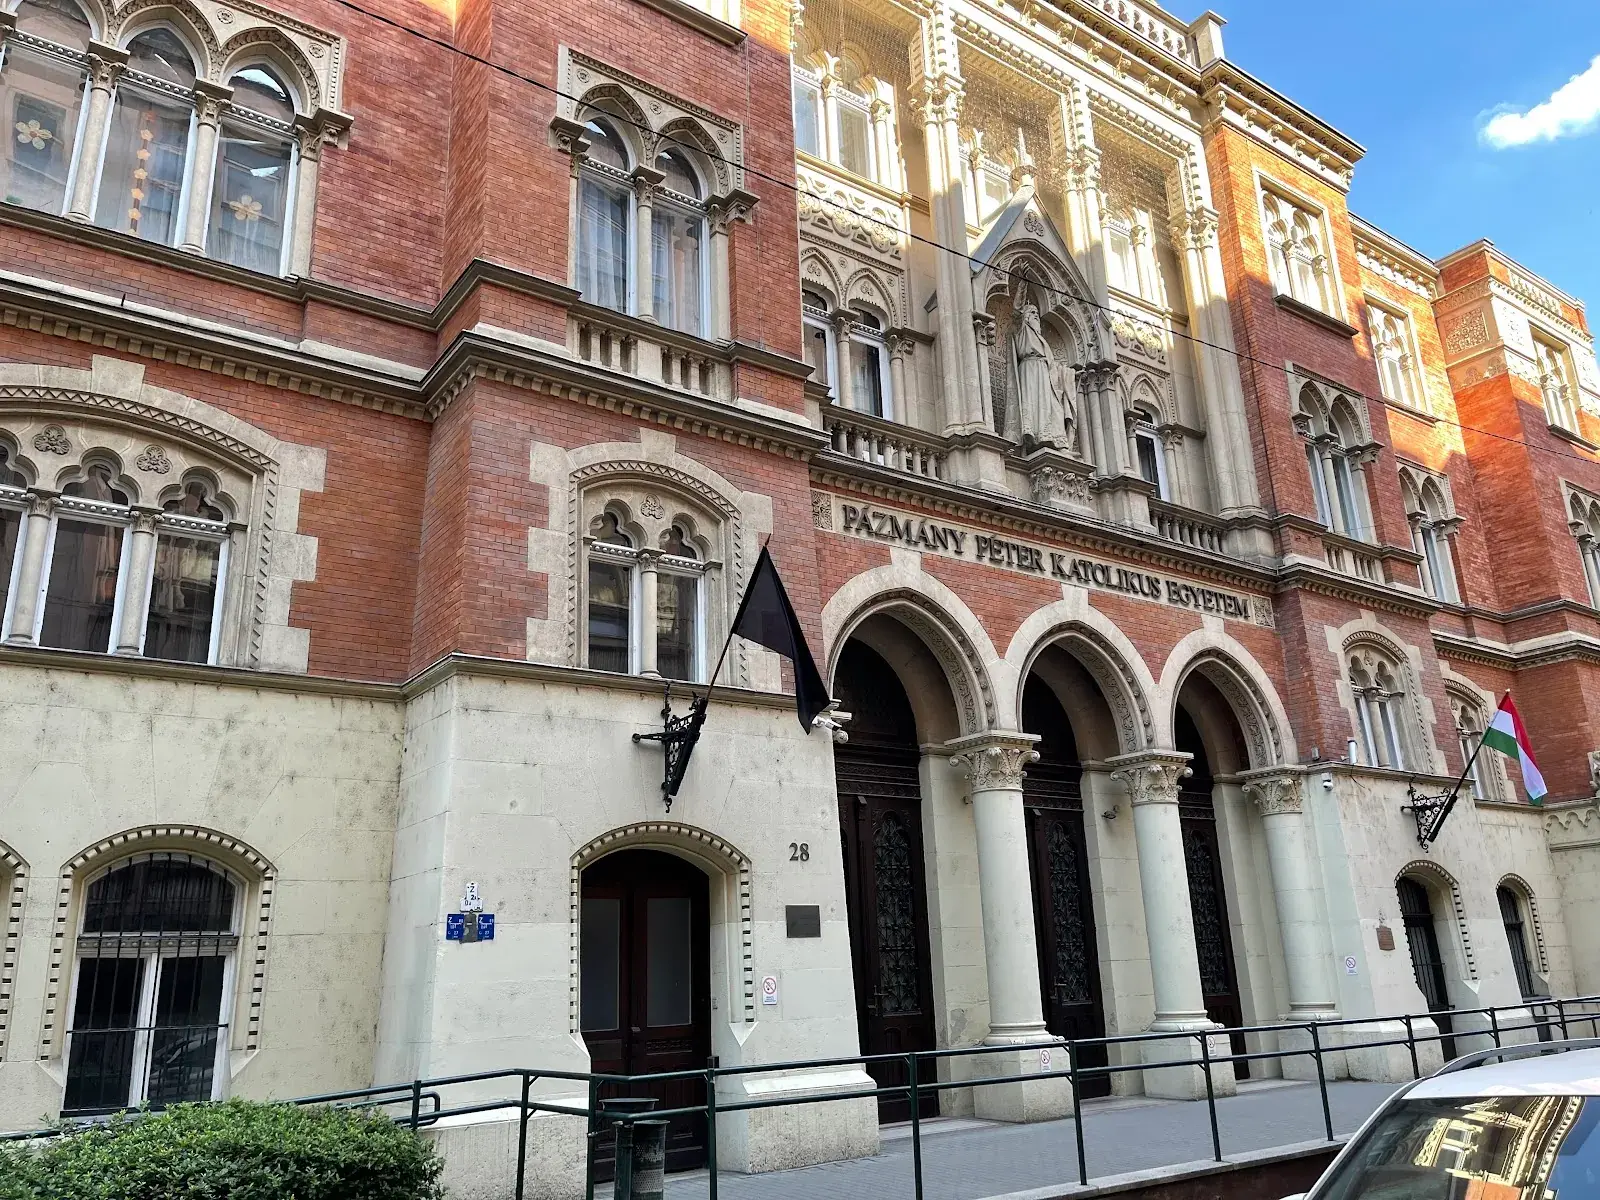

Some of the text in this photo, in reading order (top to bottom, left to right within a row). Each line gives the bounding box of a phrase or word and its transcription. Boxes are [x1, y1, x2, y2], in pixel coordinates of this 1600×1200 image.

[842, 504, 1251, 620] PÁZMÁNY PÉTER KATOLIKUS EGYETEM
[788, 842, 810, 862] 28
